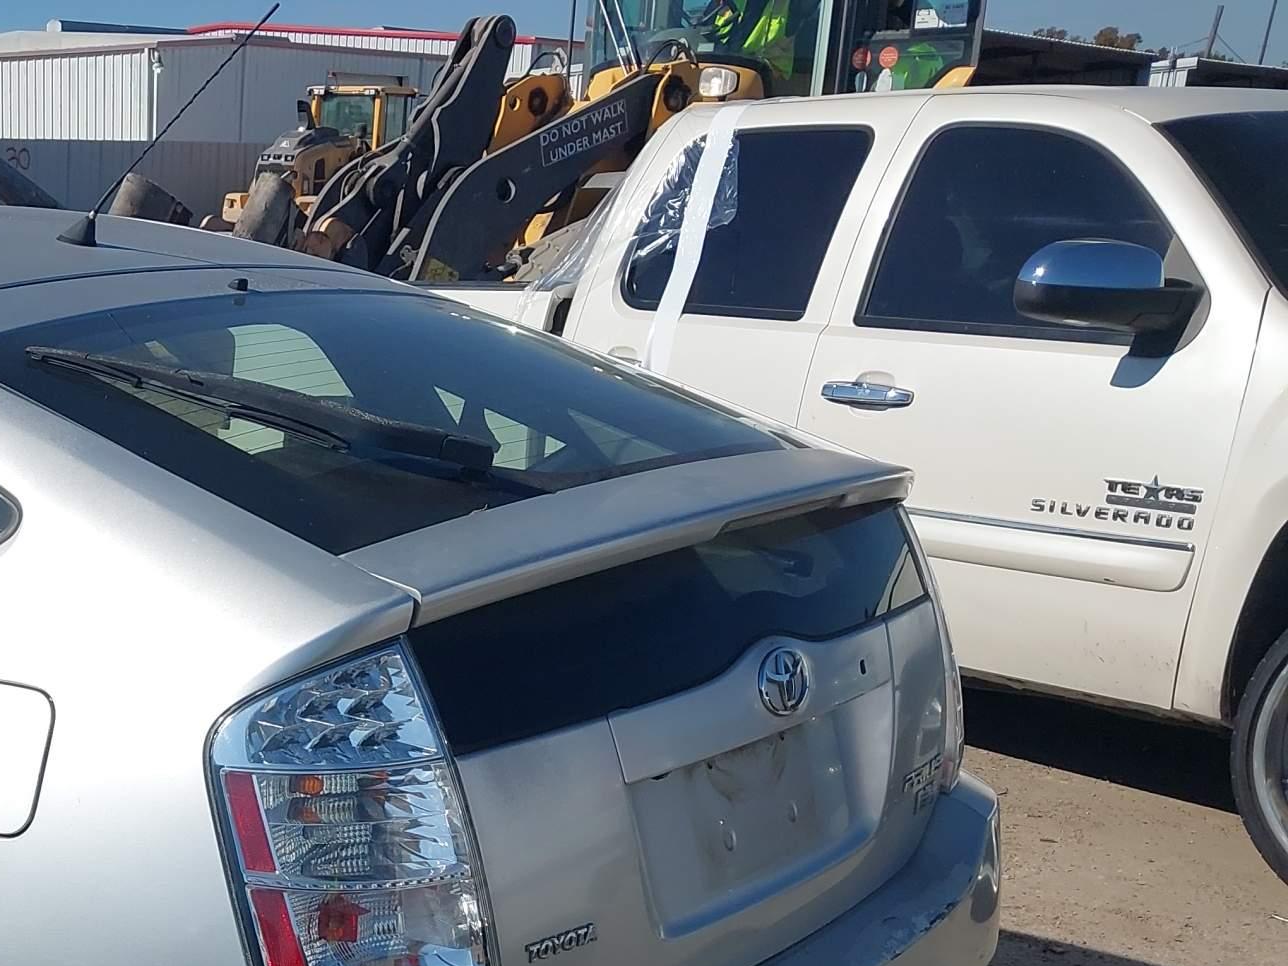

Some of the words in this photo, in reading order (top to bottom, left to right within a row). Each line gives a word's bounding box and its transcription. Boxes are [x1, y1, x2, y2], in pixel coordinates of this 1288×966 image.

[539, 129, 559, 146] DO
[562, 116, 590, 138] NOT
[591, 100, 625, 125] WALK
[550, 137, 590, 161] UNDER
[592, 121, 623, 145] MAST
[1104, 475, 1204, 503] TEXAS
[1030, 498, 1195, 531] SILVERADO
[524, 922, 598, 964] TOYOTA
